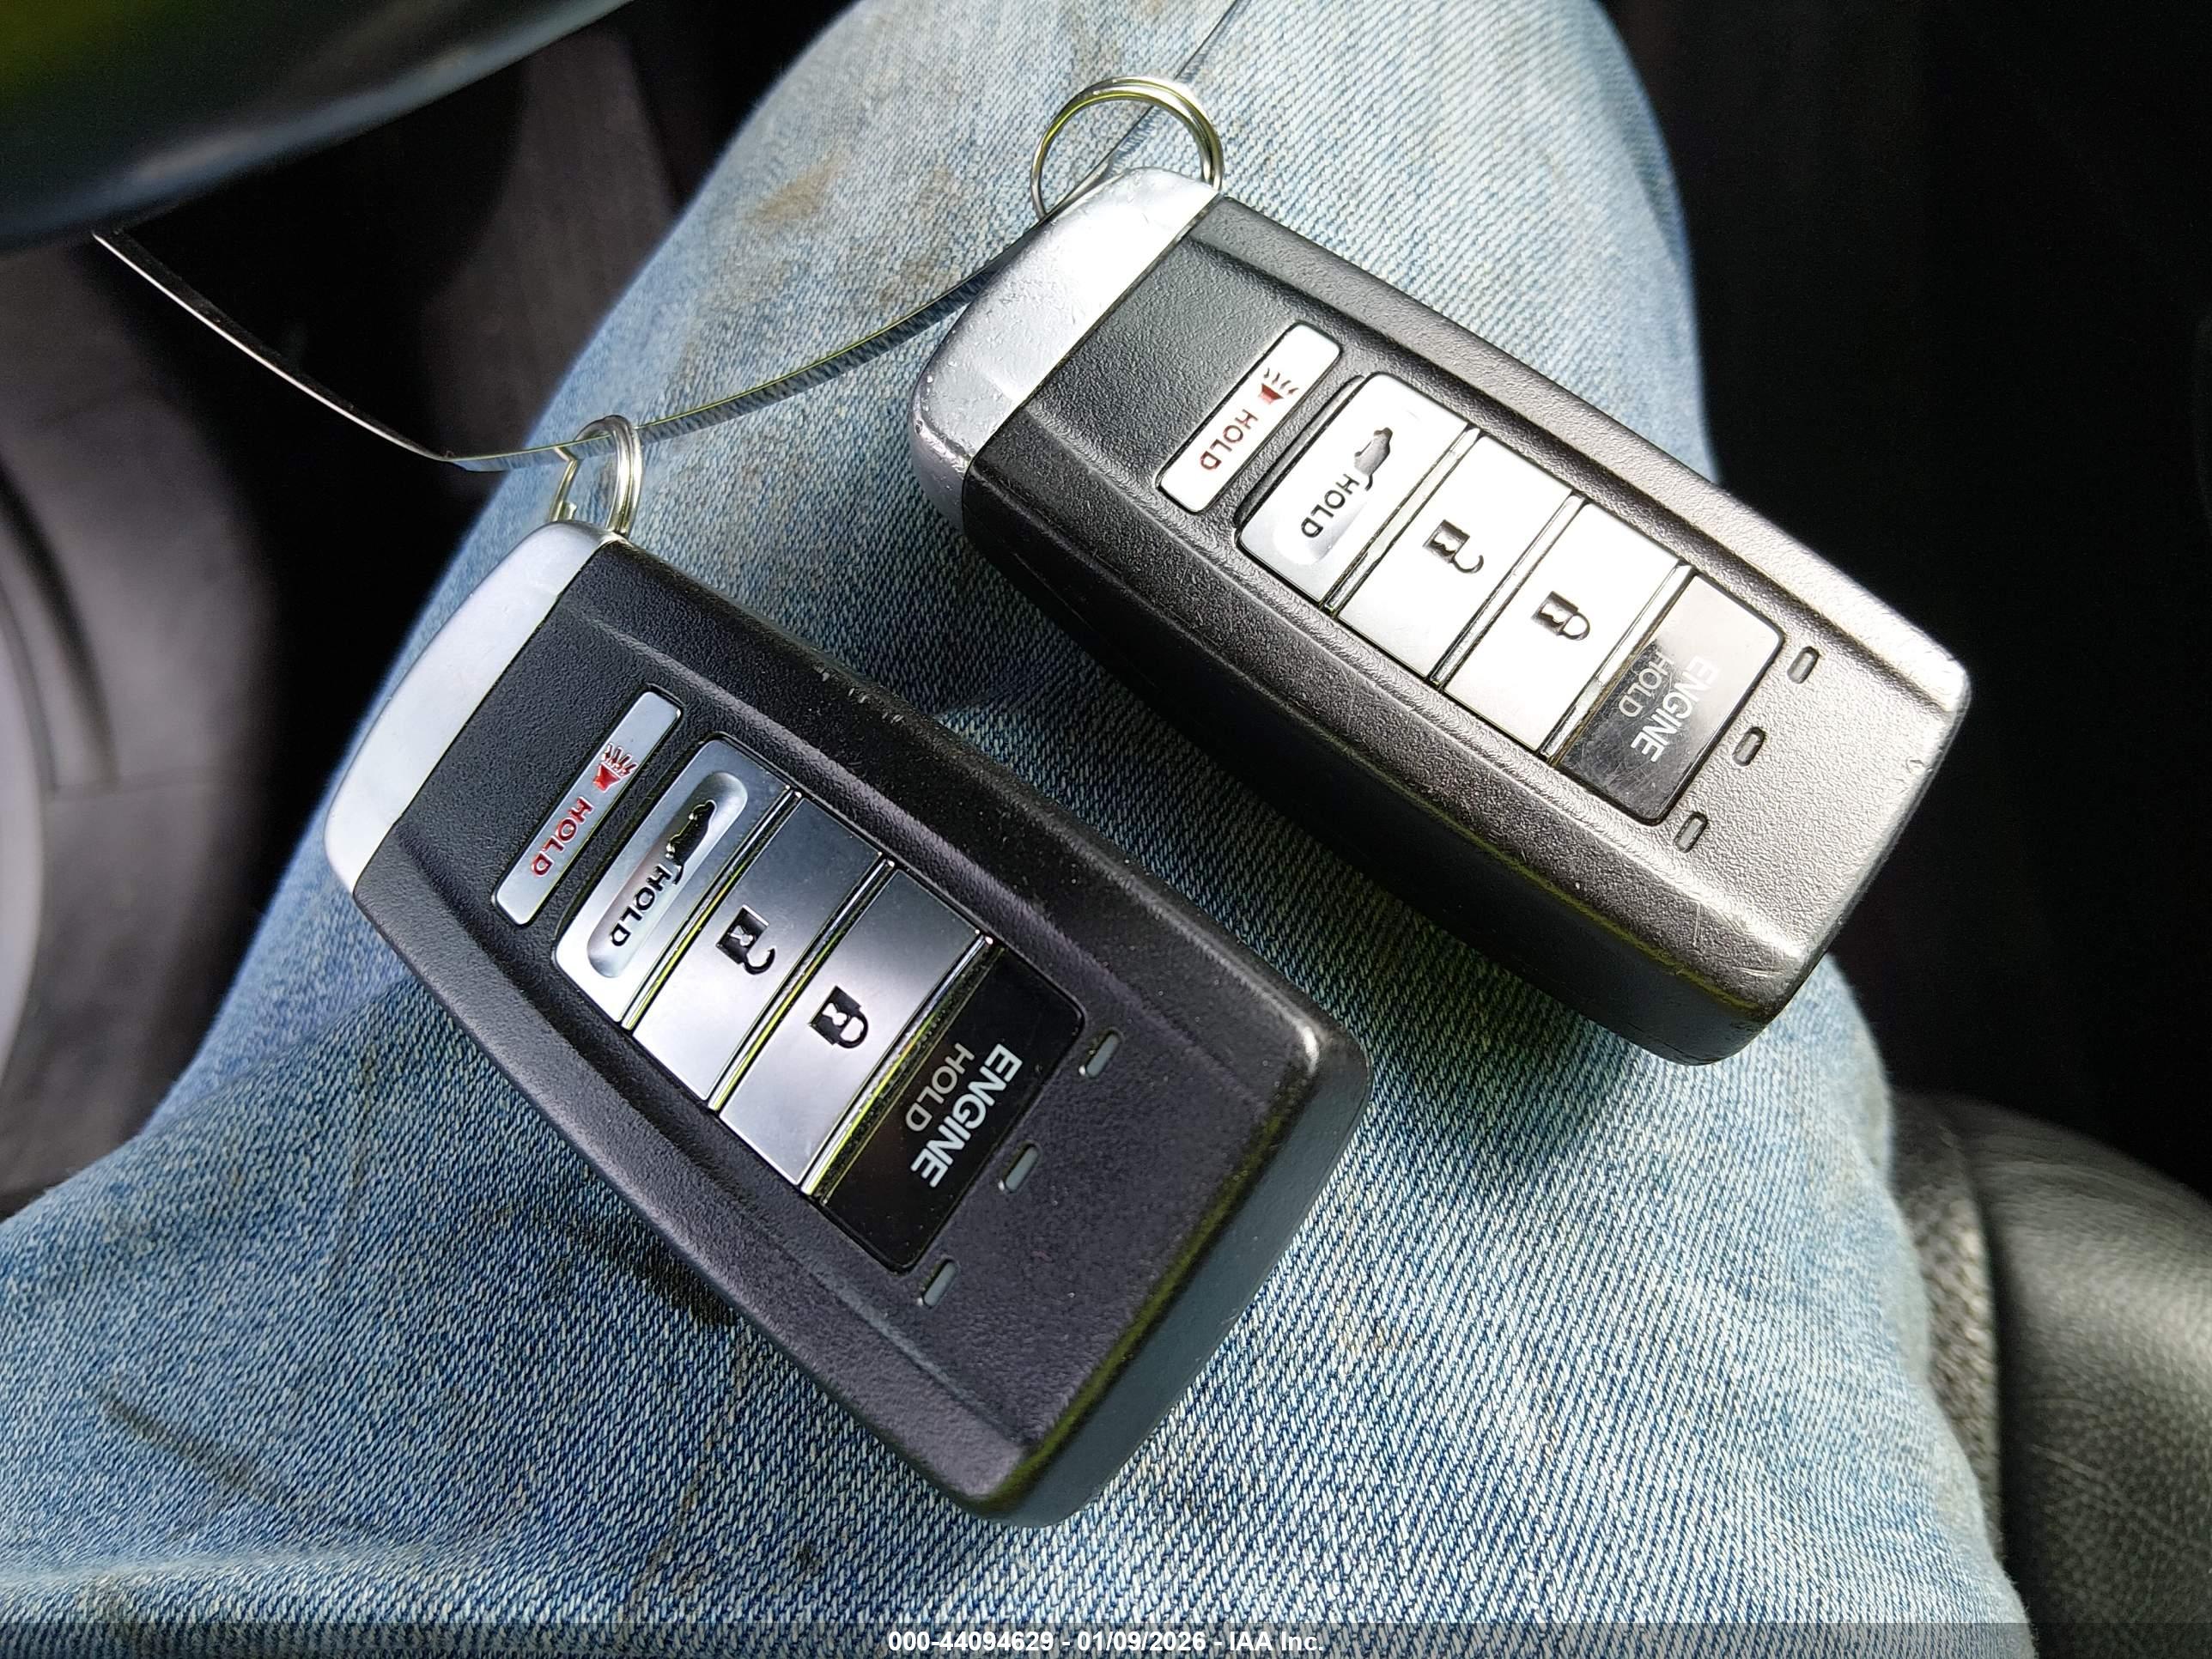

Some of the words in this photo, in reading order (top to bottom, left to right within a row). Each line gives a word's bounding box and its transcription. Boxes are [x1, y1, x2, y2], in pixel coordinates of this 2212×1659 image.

[1200, 409, 1259, 471] HOLD
[1300, 473, 1360, 538] HOLD
[1618, 651, 1674, 718] HOLD
[1630, 655, 1719, 763] ENGINE
[531, 796, 594, 878] HOLD
[610, 863, 672, 946] HOLD
[905, 1042, 975, 1132] HOLD
[910, 1043, 1023, 1188] ENGINE
